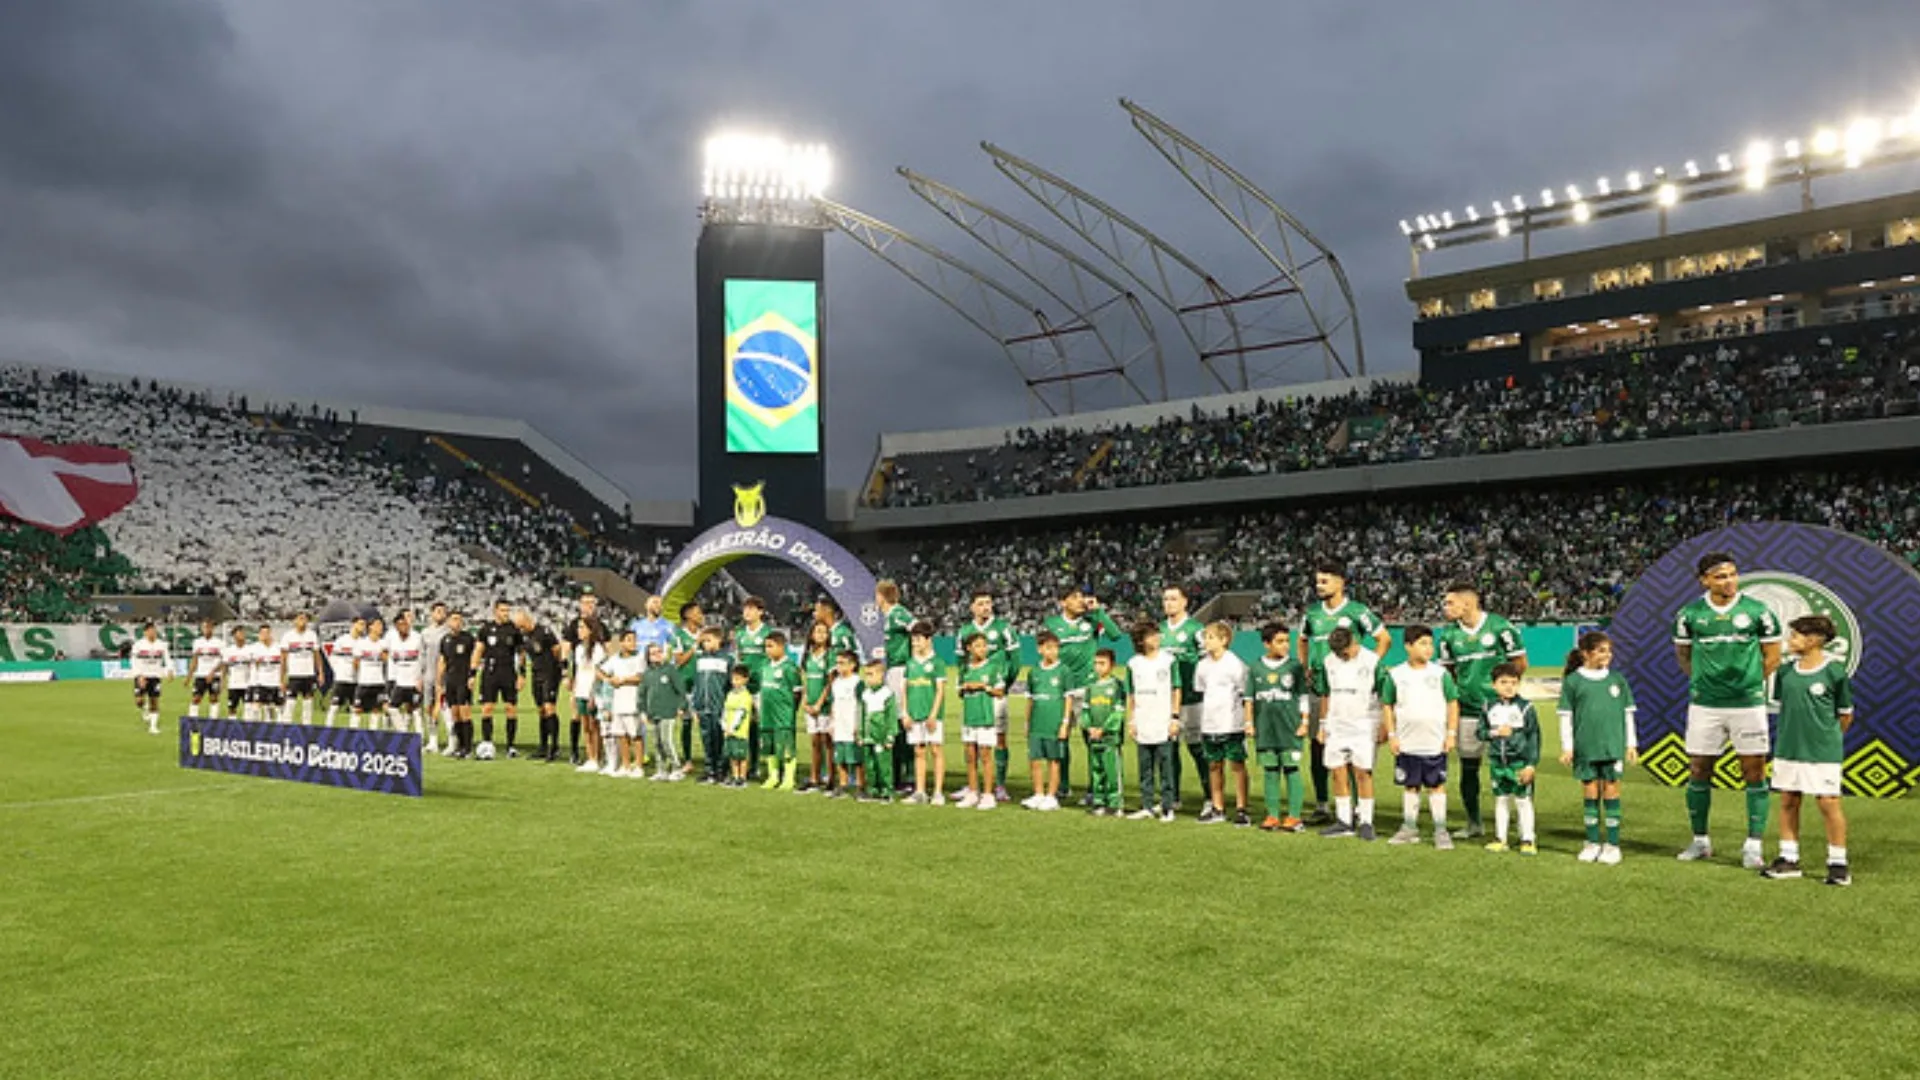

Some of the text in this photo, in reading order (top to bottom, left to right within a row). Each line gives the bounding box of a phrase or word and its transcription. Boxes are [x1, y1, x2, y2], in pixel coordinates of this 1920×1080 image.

[661, 527, 786, 596] ASILEIRÃO
[203, 738, 408, 777] BRASILEIRÃO Betano 2025
